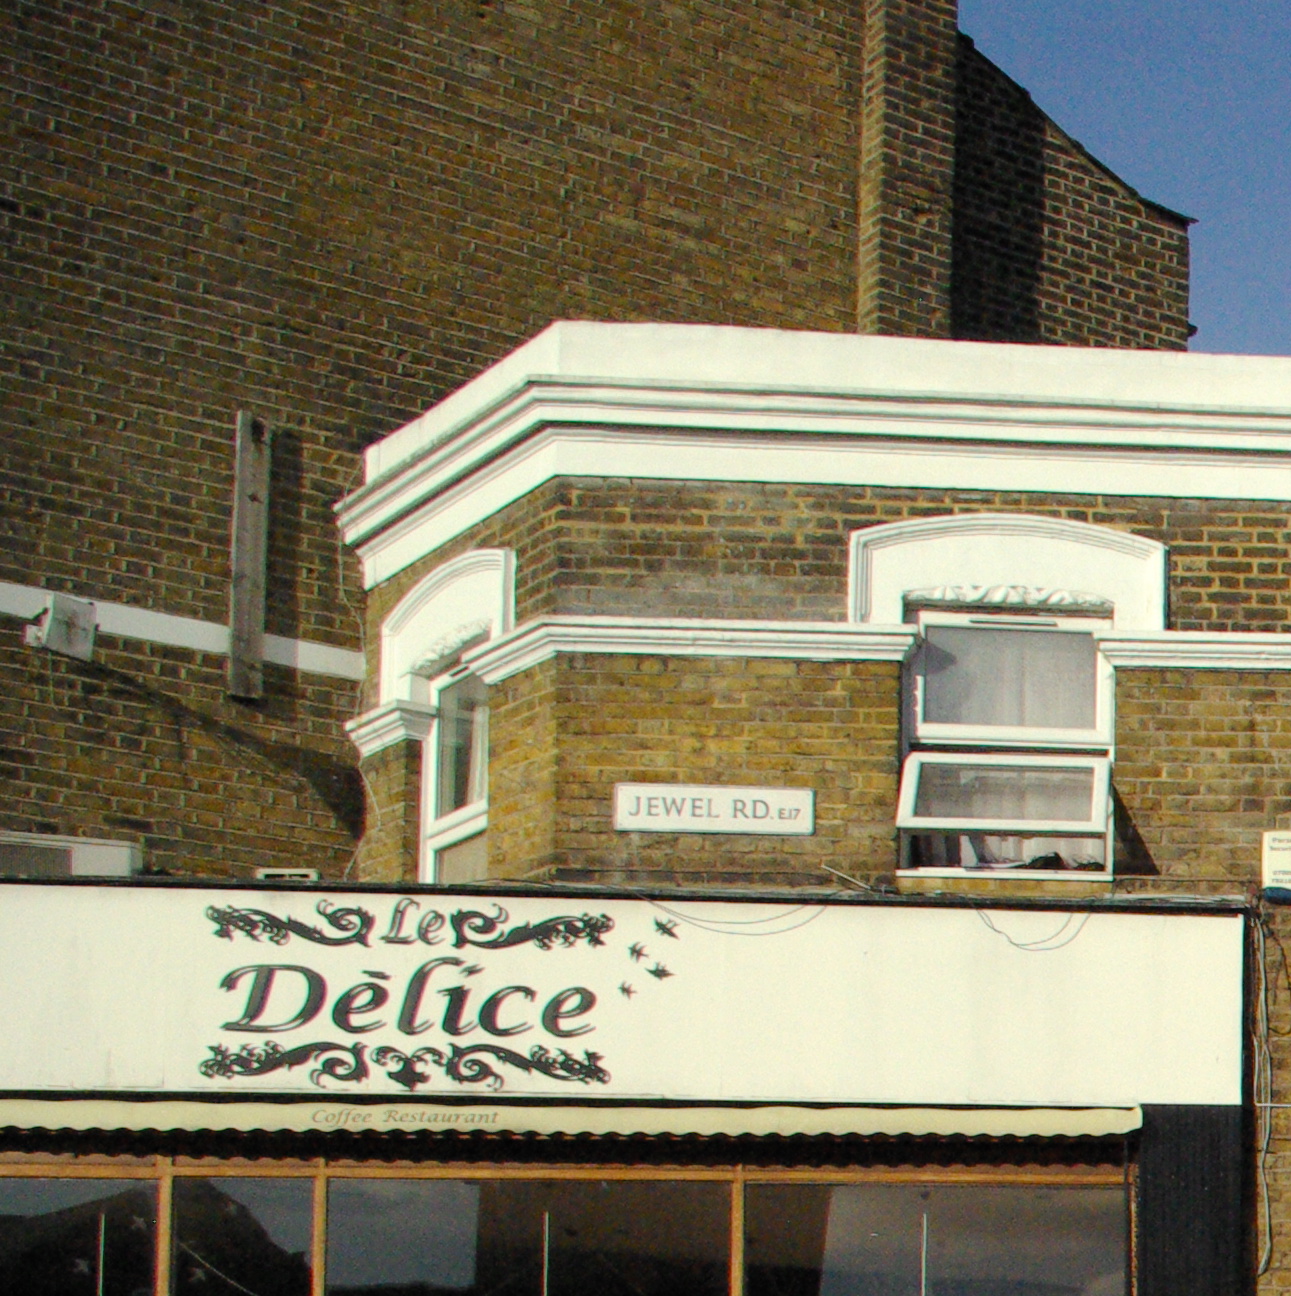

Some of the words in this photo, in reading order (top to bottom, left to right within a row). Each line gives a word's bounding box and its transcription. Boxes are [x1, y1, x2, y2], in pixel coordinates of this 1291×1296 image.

[628, 795, 720, 818] JEWEL
[379, 897, 447, 945] Le
[311, 1108, 373, 1128] Coffee
[382, 1109, 500, 1124] Restaurant
